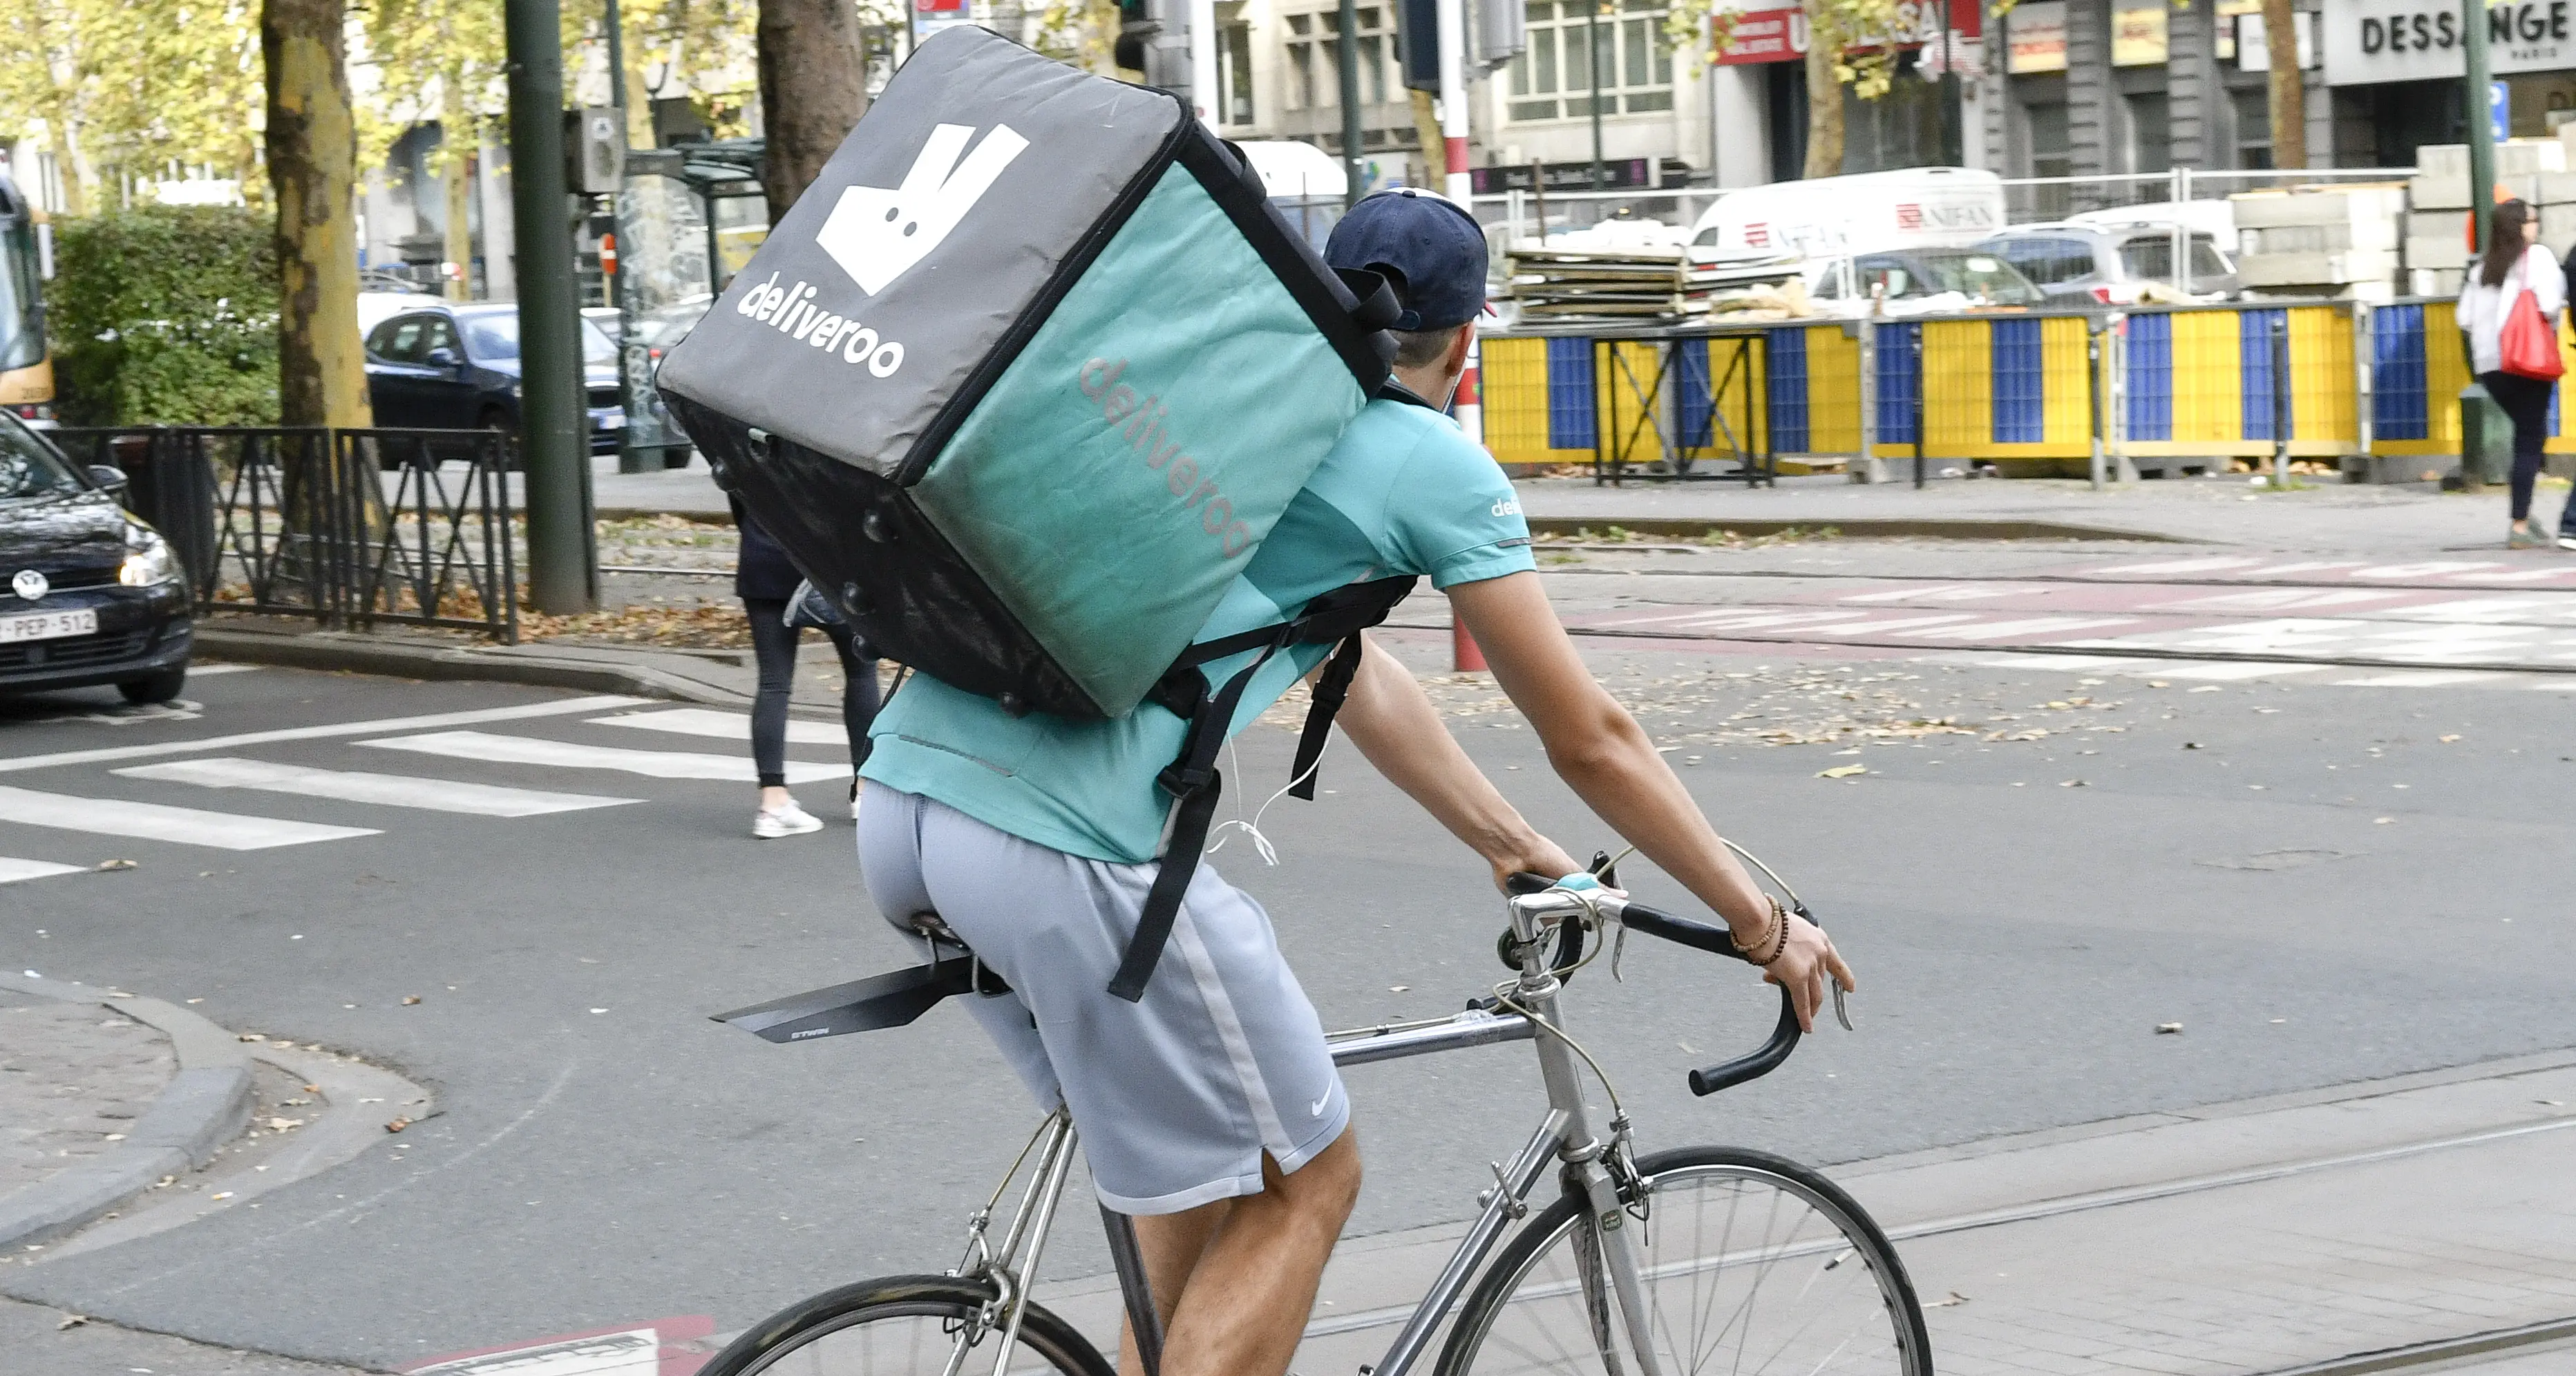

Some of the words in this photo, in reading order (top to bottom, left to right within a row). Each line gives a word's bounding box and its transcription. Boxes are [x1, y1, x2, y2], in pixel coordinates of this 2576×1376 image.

[2360, 1, 2568, 55] DESSNGE
[737, 271, 905, 378] deliveroo
[1080, 357, 1250, 559] deliveroo
[0, 612, 95, 639] -PEP-512
